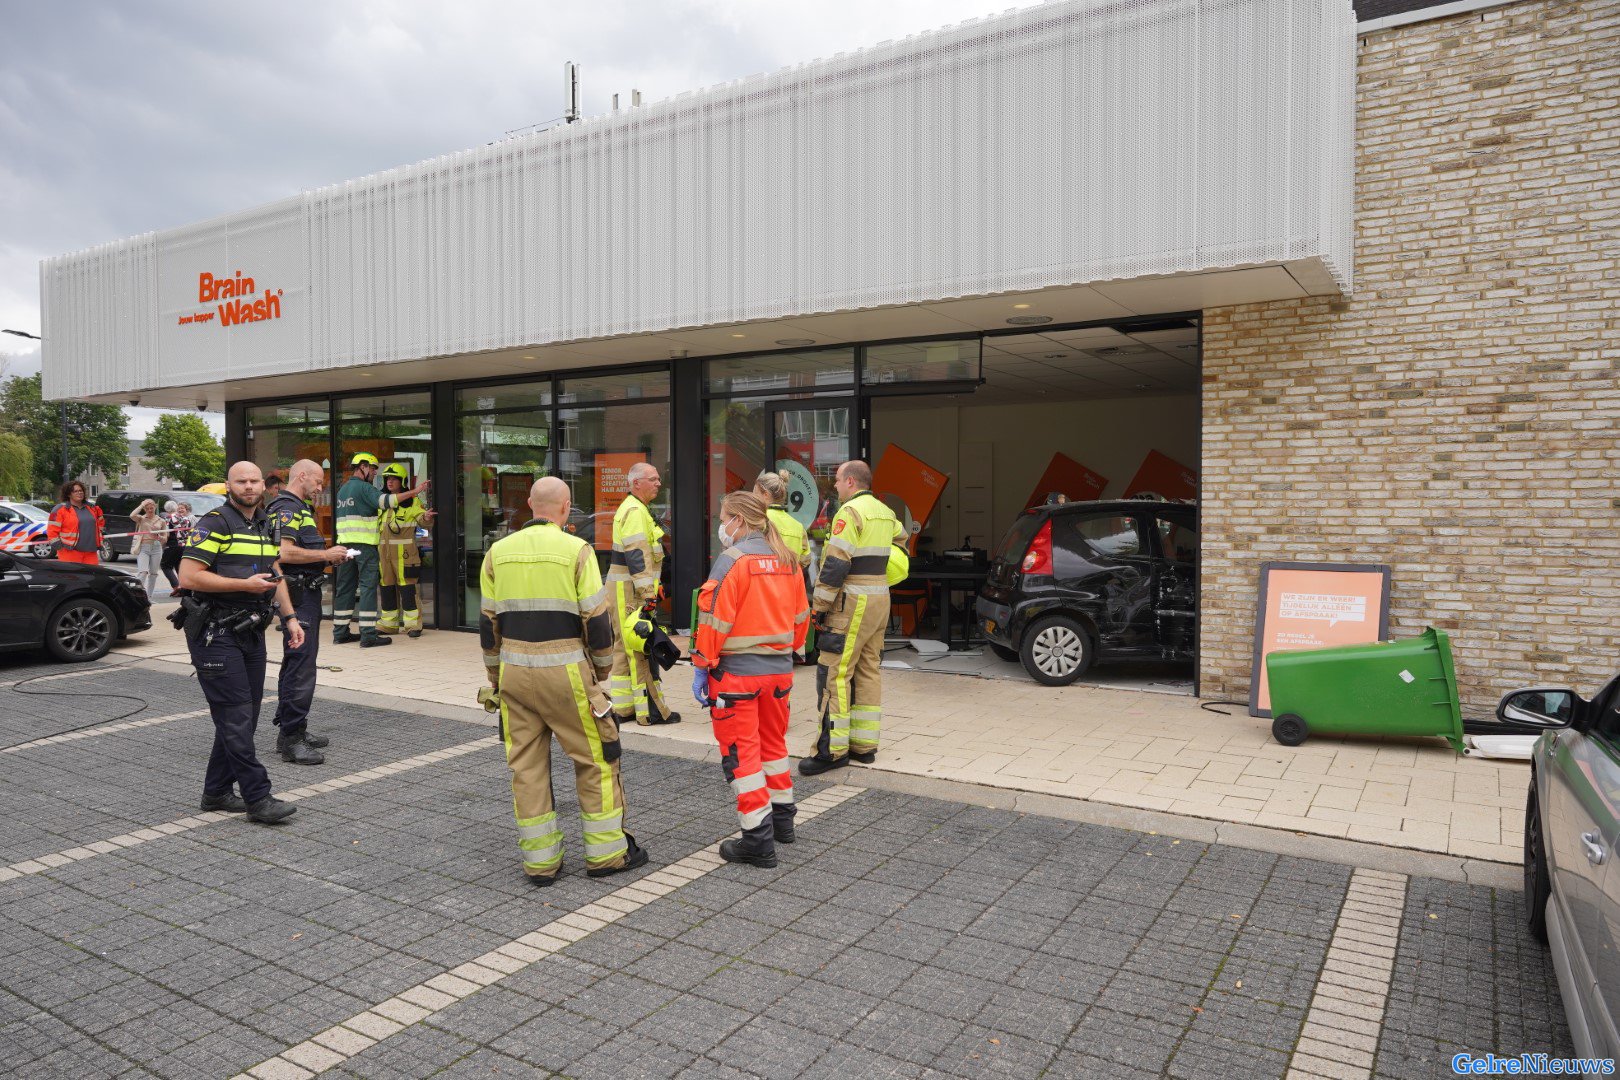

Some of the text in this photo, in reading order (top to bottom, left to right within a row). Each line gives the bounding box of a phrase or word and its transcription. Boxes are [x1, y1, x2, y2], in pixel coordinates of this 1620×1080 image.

[199, 270, 255, 303] Brain
[194, 312, 215, 323] kapper
[1282, 602, 1319, 610] TIJDELIJK
